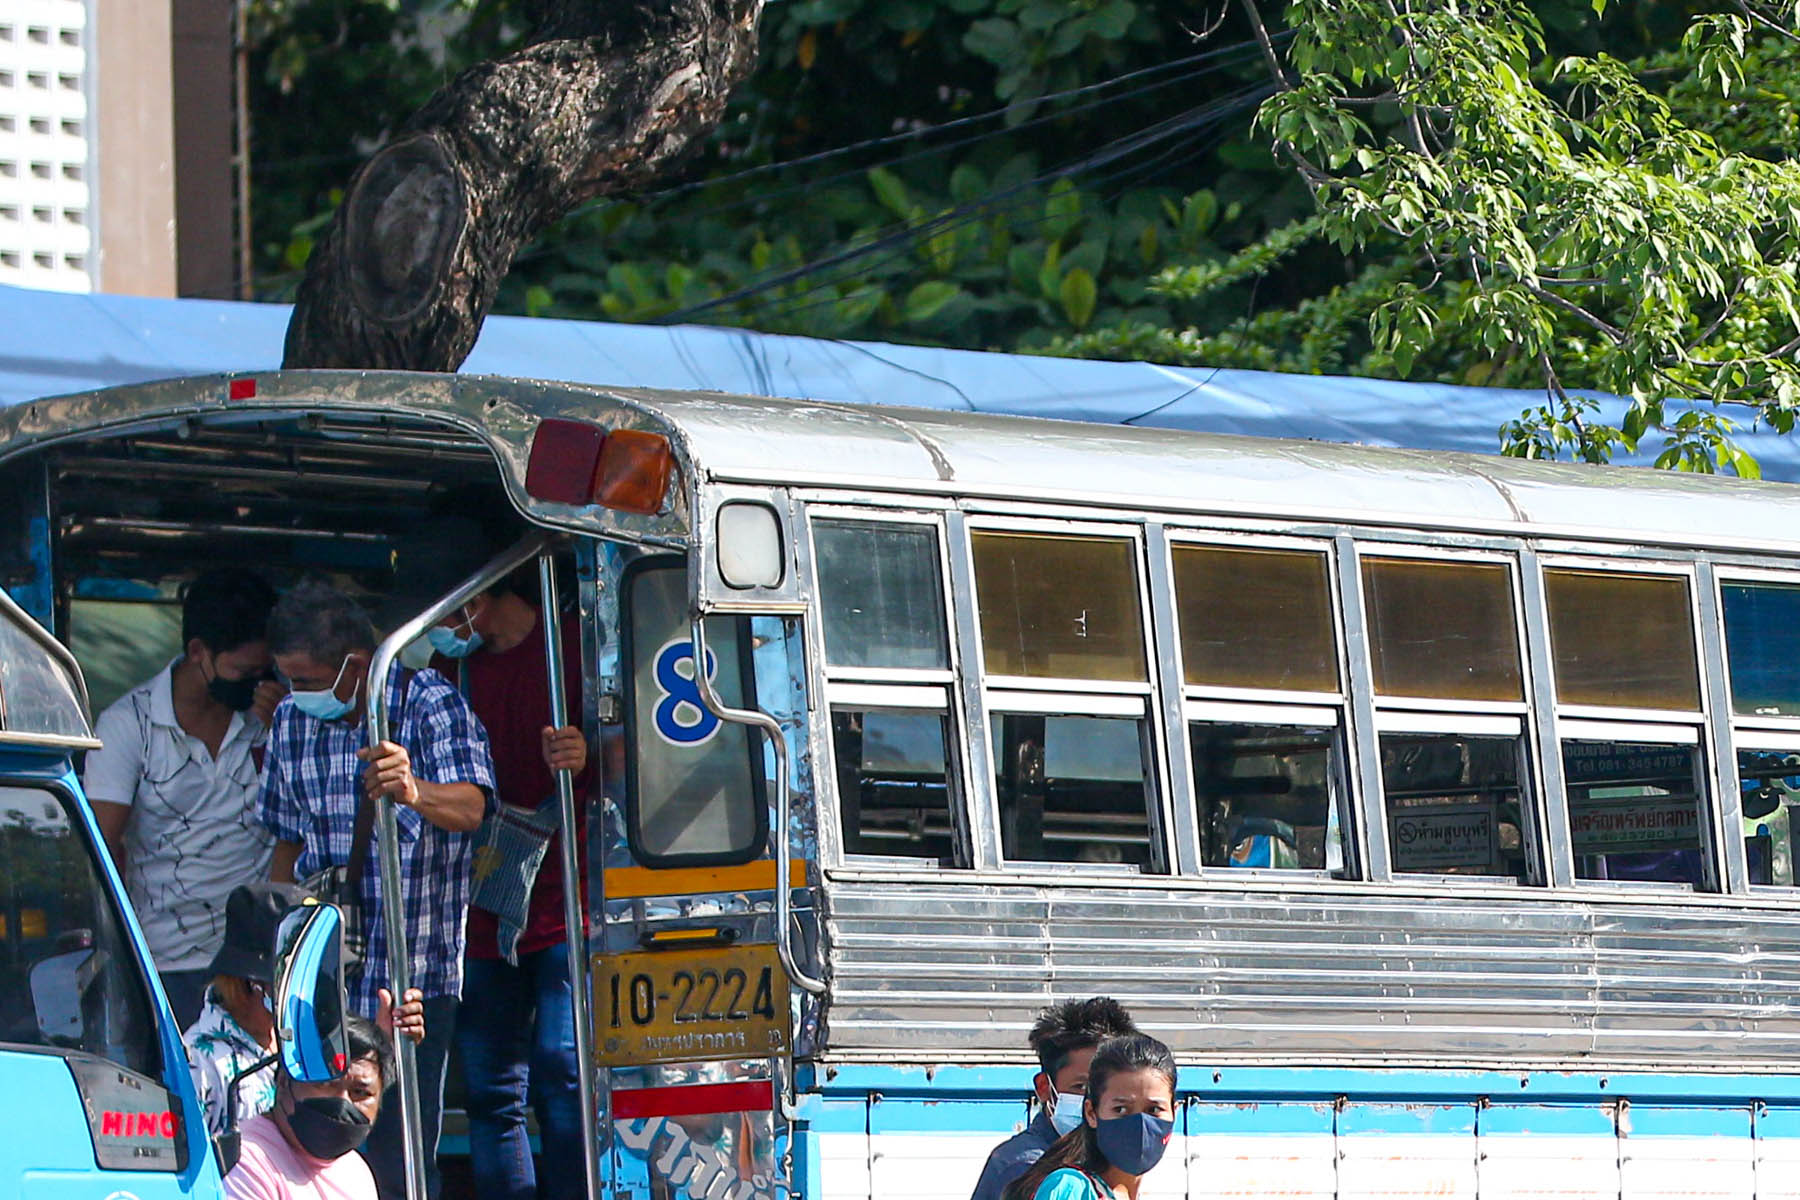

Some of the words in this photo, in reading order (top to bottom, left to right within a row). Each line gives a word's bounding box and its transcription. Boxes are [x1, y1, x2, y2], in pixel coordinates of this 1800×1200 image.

[651, 636, 724, 747] 8
[610, 965, 775, 1028] 10-2224
[102, 1110, 179, 1139] HINO
